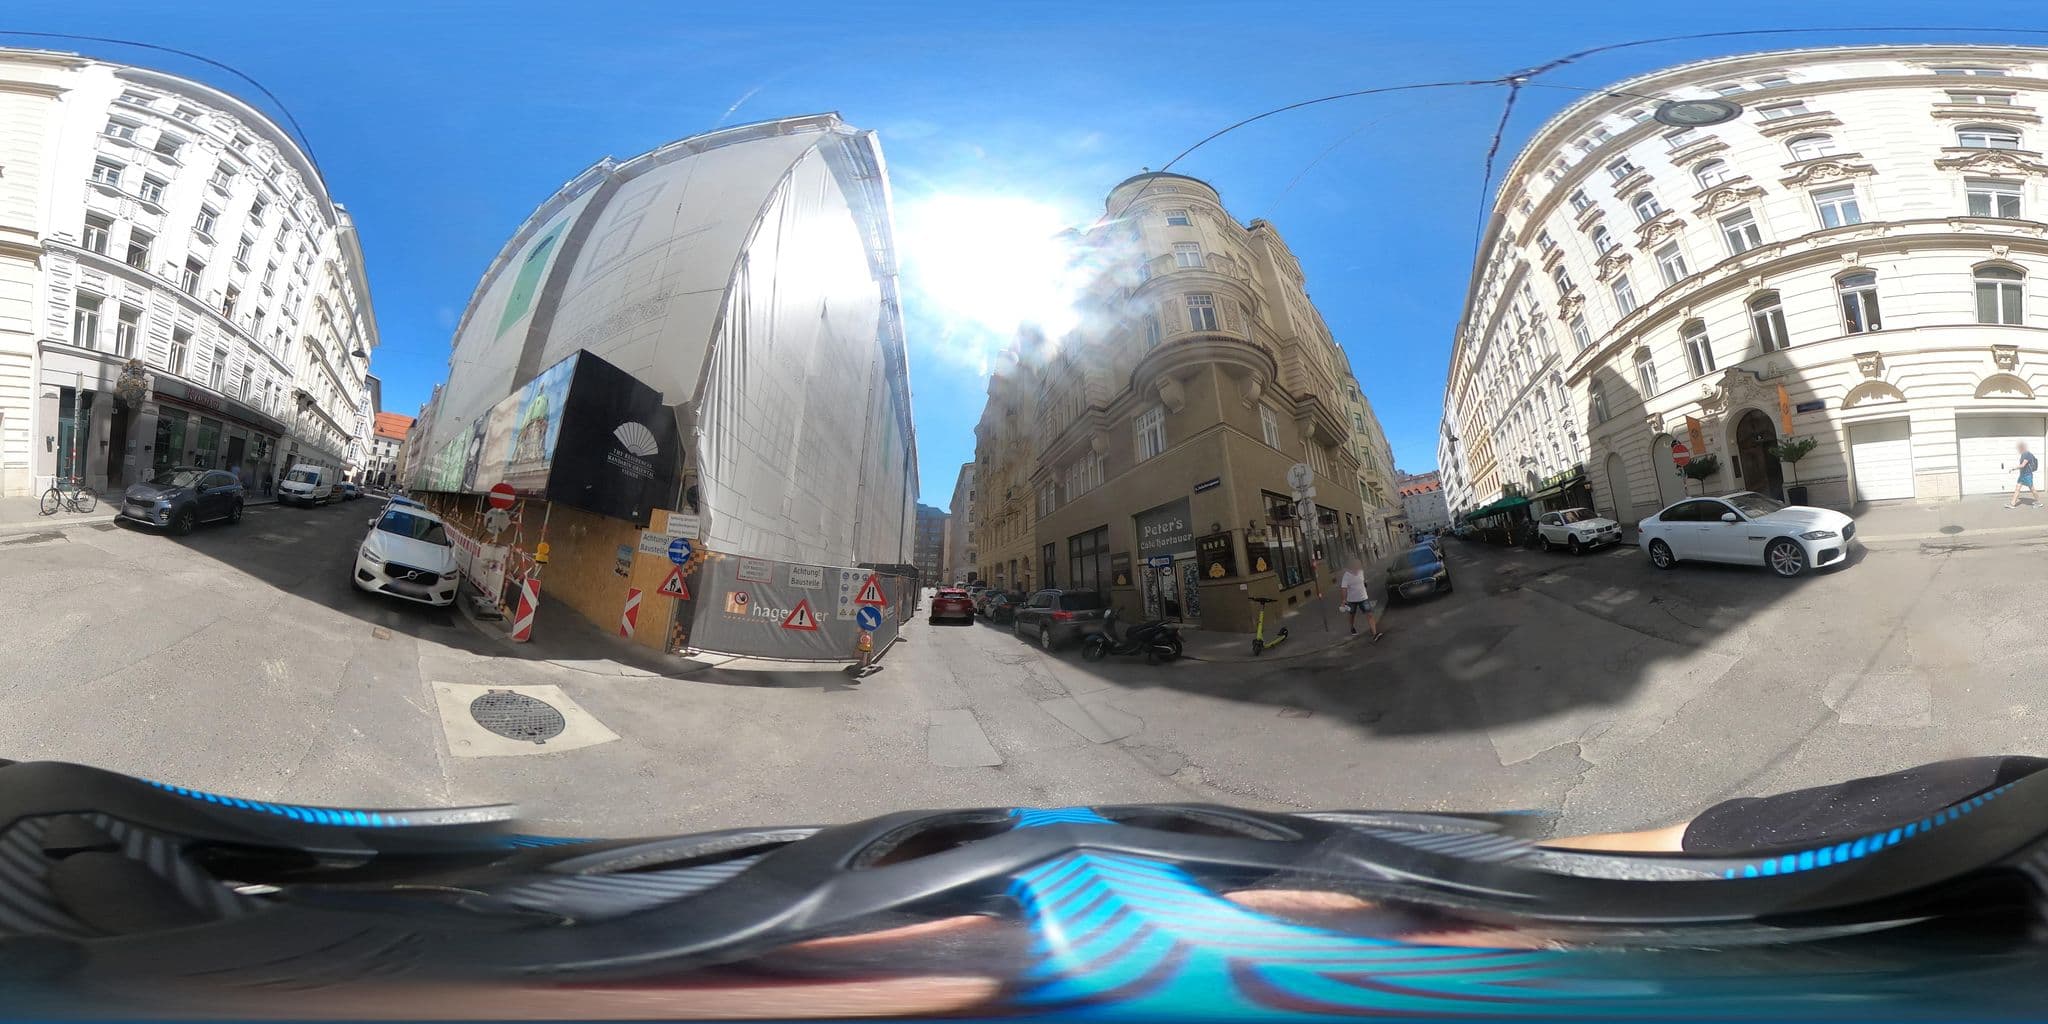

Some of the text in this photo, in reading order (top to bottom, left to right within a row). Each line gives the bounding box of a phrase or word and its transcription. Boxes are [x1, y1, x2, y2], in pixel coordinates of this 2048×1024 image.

[1144, 517, 1183, 537] Peter's
[793, 567, 821, 578] Achtung!
[791, 577, 820, 587] Baustelle
[753, 602, 830, 622] hageer
